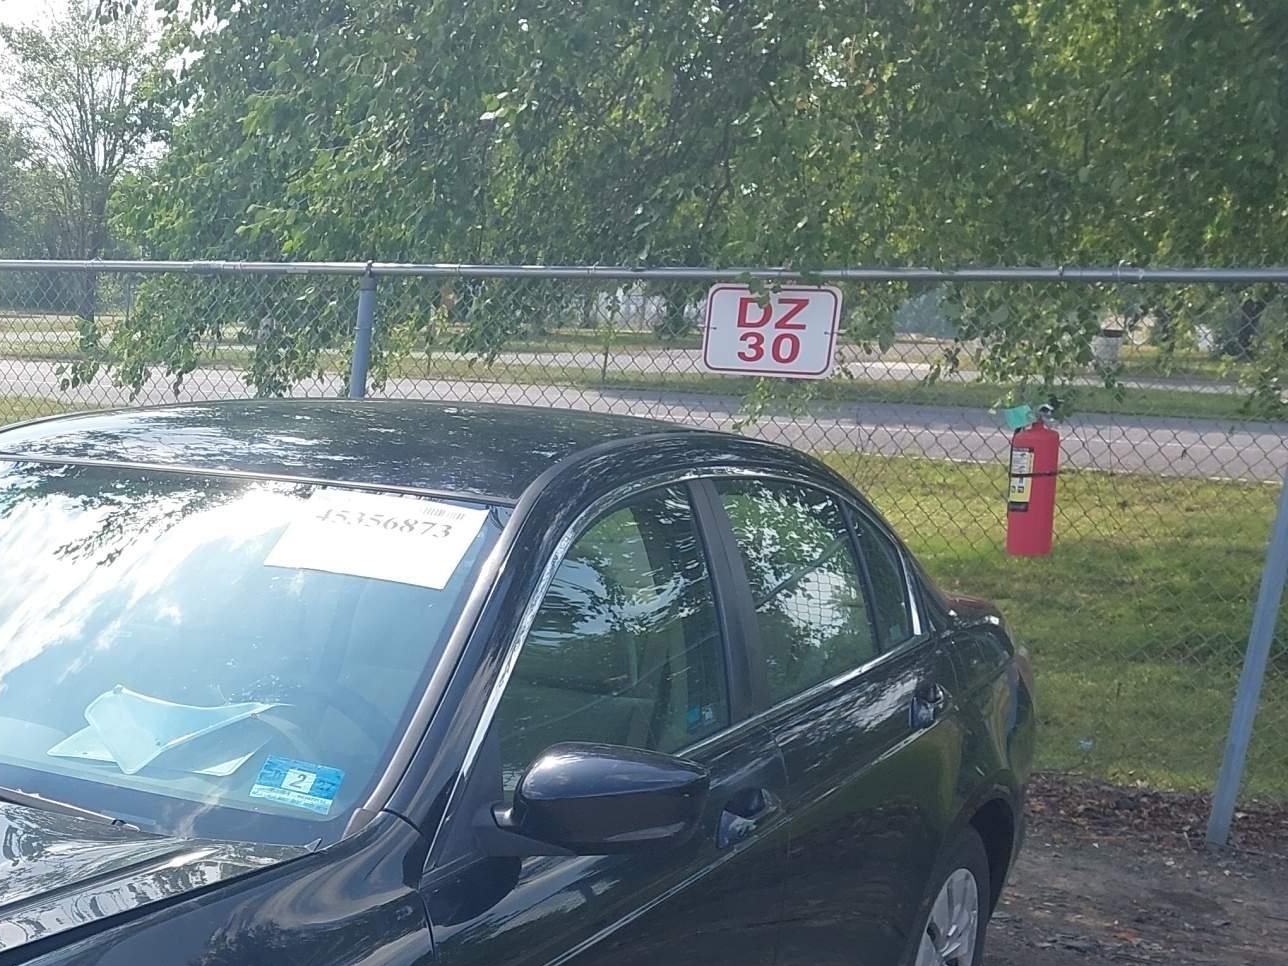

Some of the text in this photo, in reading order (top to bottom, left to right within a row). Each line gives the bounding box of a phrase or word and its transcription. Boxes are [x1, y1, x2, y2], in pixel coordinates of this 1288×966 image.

[737, 297, 810, 330] DZ
[737, 331, 801, 364] 30
[315, 508, 454, 539] 45356873
[289, 773, 308, 789] 2
